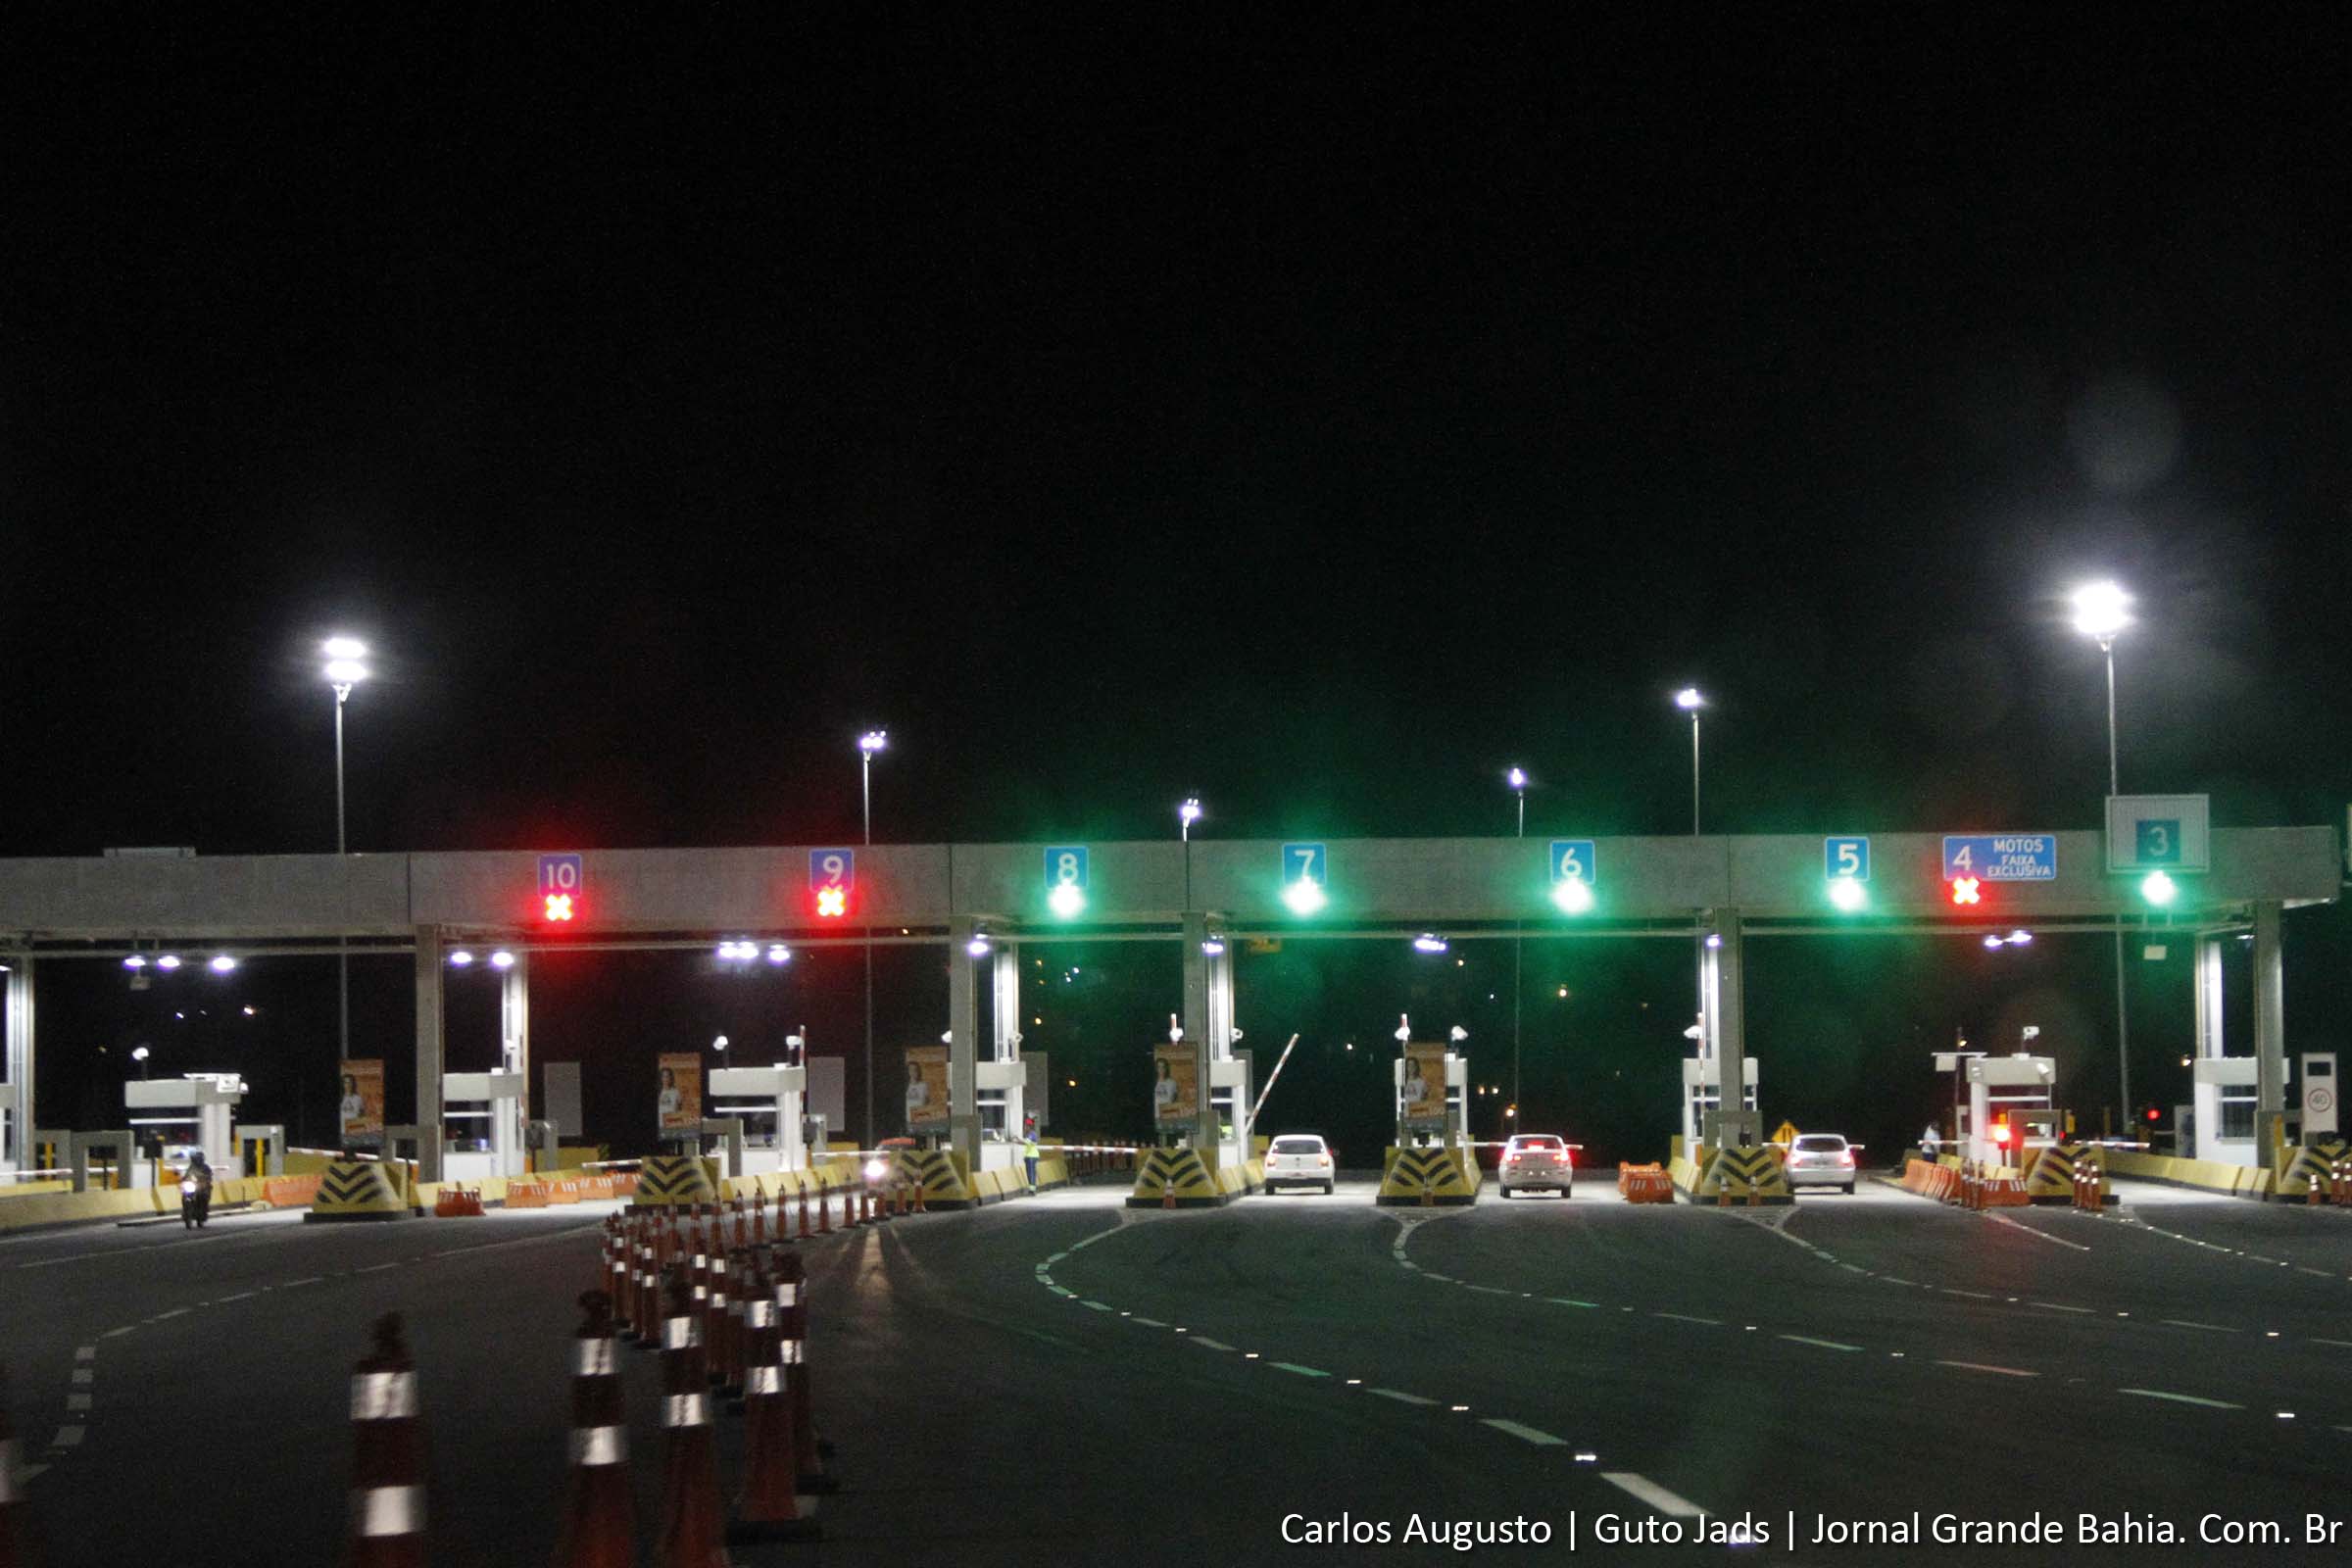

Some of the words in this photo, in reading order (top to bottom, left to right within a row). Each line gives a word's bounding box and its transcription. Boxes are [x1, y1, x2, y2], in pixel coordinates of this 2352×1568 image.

[1993, 838, 2044, 854] MOTOS
[2148, 826, 2170, 857] 3
[823, 855, 844, 886] 9
[1057, 853, 1079, 884] 8
[1295, 850, 1315, 881] 7
[1560, 847, 1583, 878] 6
[1838, 844, 1860, 875] 5
[1953, 845, 1973, 871] 4
[1986, 865, 2051, 877] EXCLUSIVA
[2001, 855, 2036, 865] FAIXA
[547, 862, 576, 890] 10
